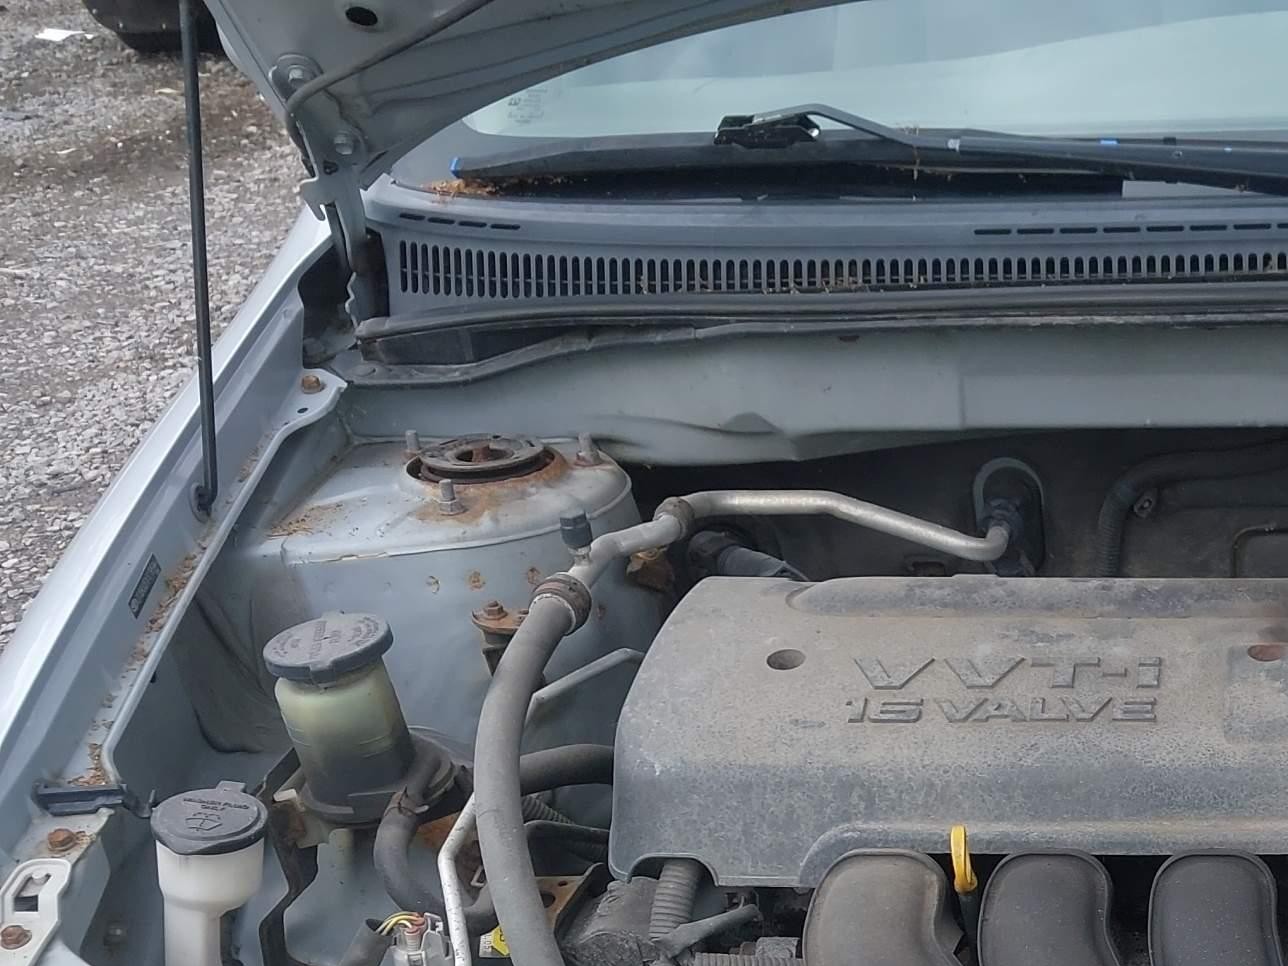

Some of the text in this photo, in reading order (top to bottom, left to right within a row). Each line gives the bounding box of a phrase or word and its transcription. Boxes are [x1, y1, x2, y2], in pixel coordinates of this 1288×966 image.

[853, 656, 1162, 690] VVT-i
[845, 697, 1158, 723] 16 VALVE
